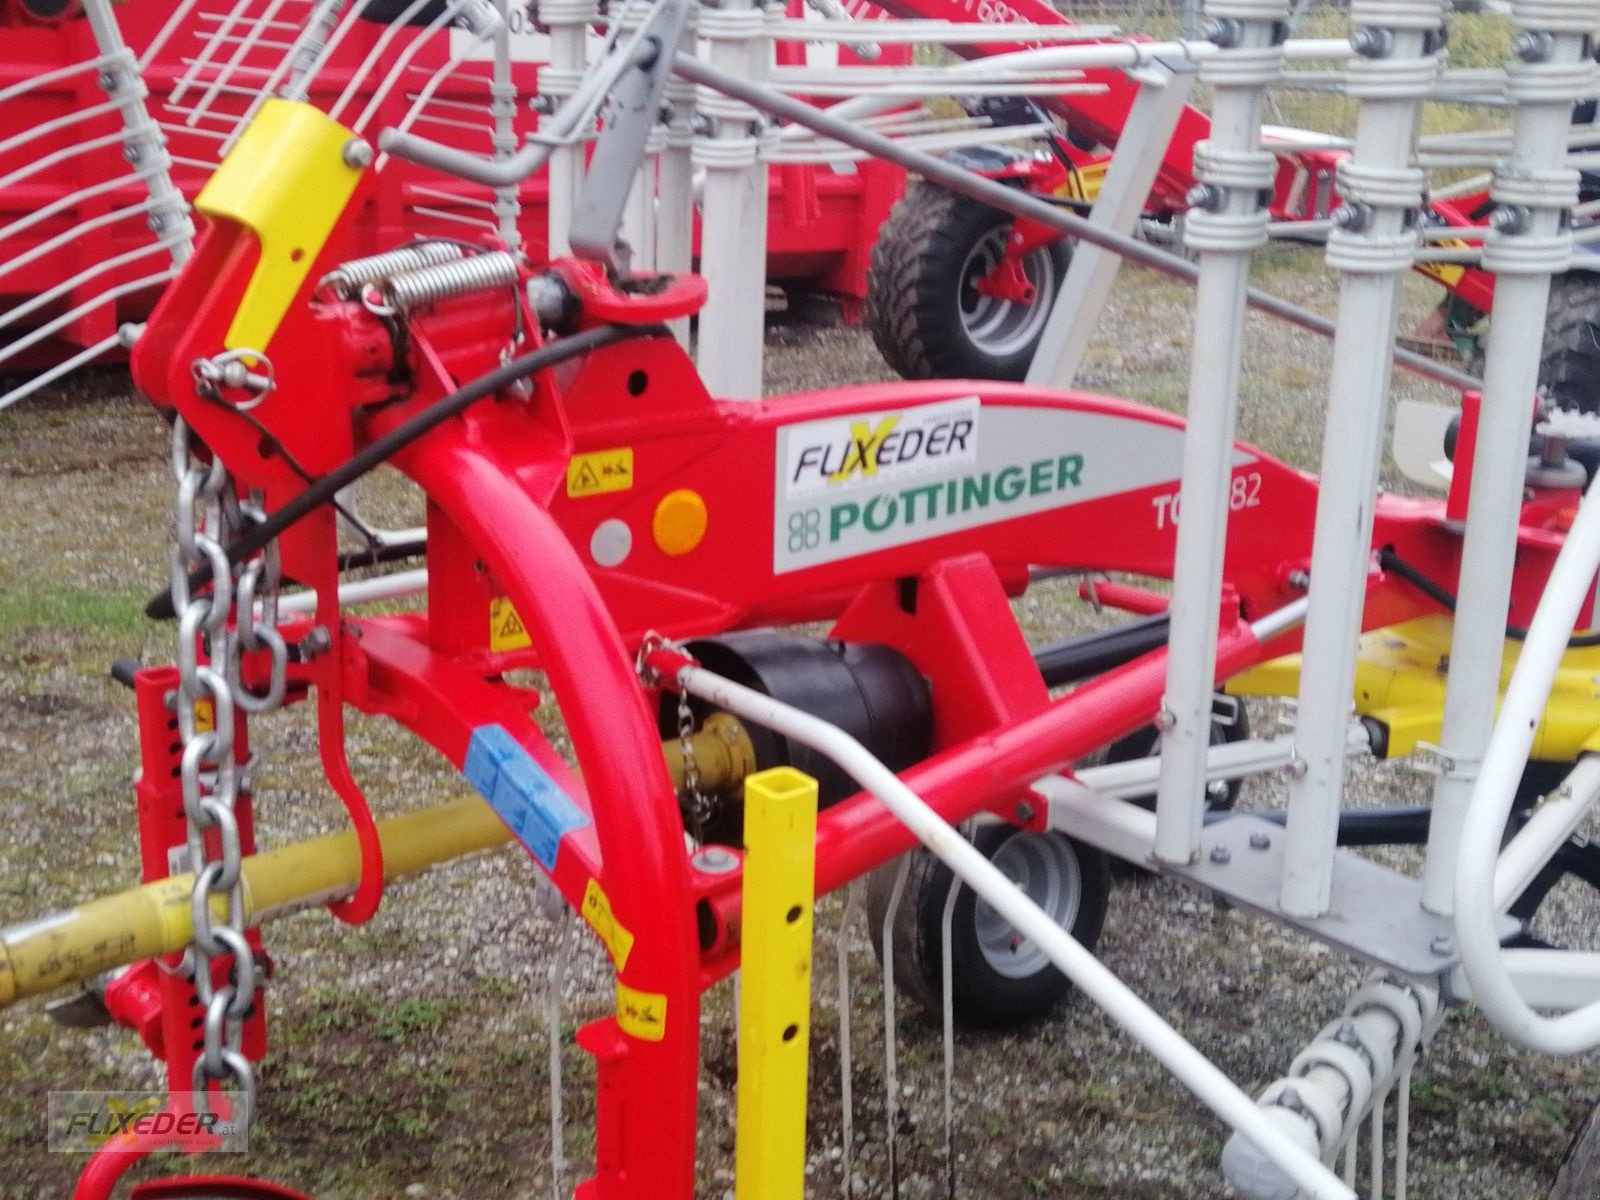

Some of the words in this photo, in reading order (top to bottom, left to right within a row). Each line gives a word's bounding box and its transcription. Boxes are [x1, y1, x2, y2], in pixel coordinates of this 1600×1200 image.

[793, 418, 974, 484] FLIXEDER
[829, 453, 1085, 542] PÖTTINGER
[1230, 471, 1261, 511] 82
